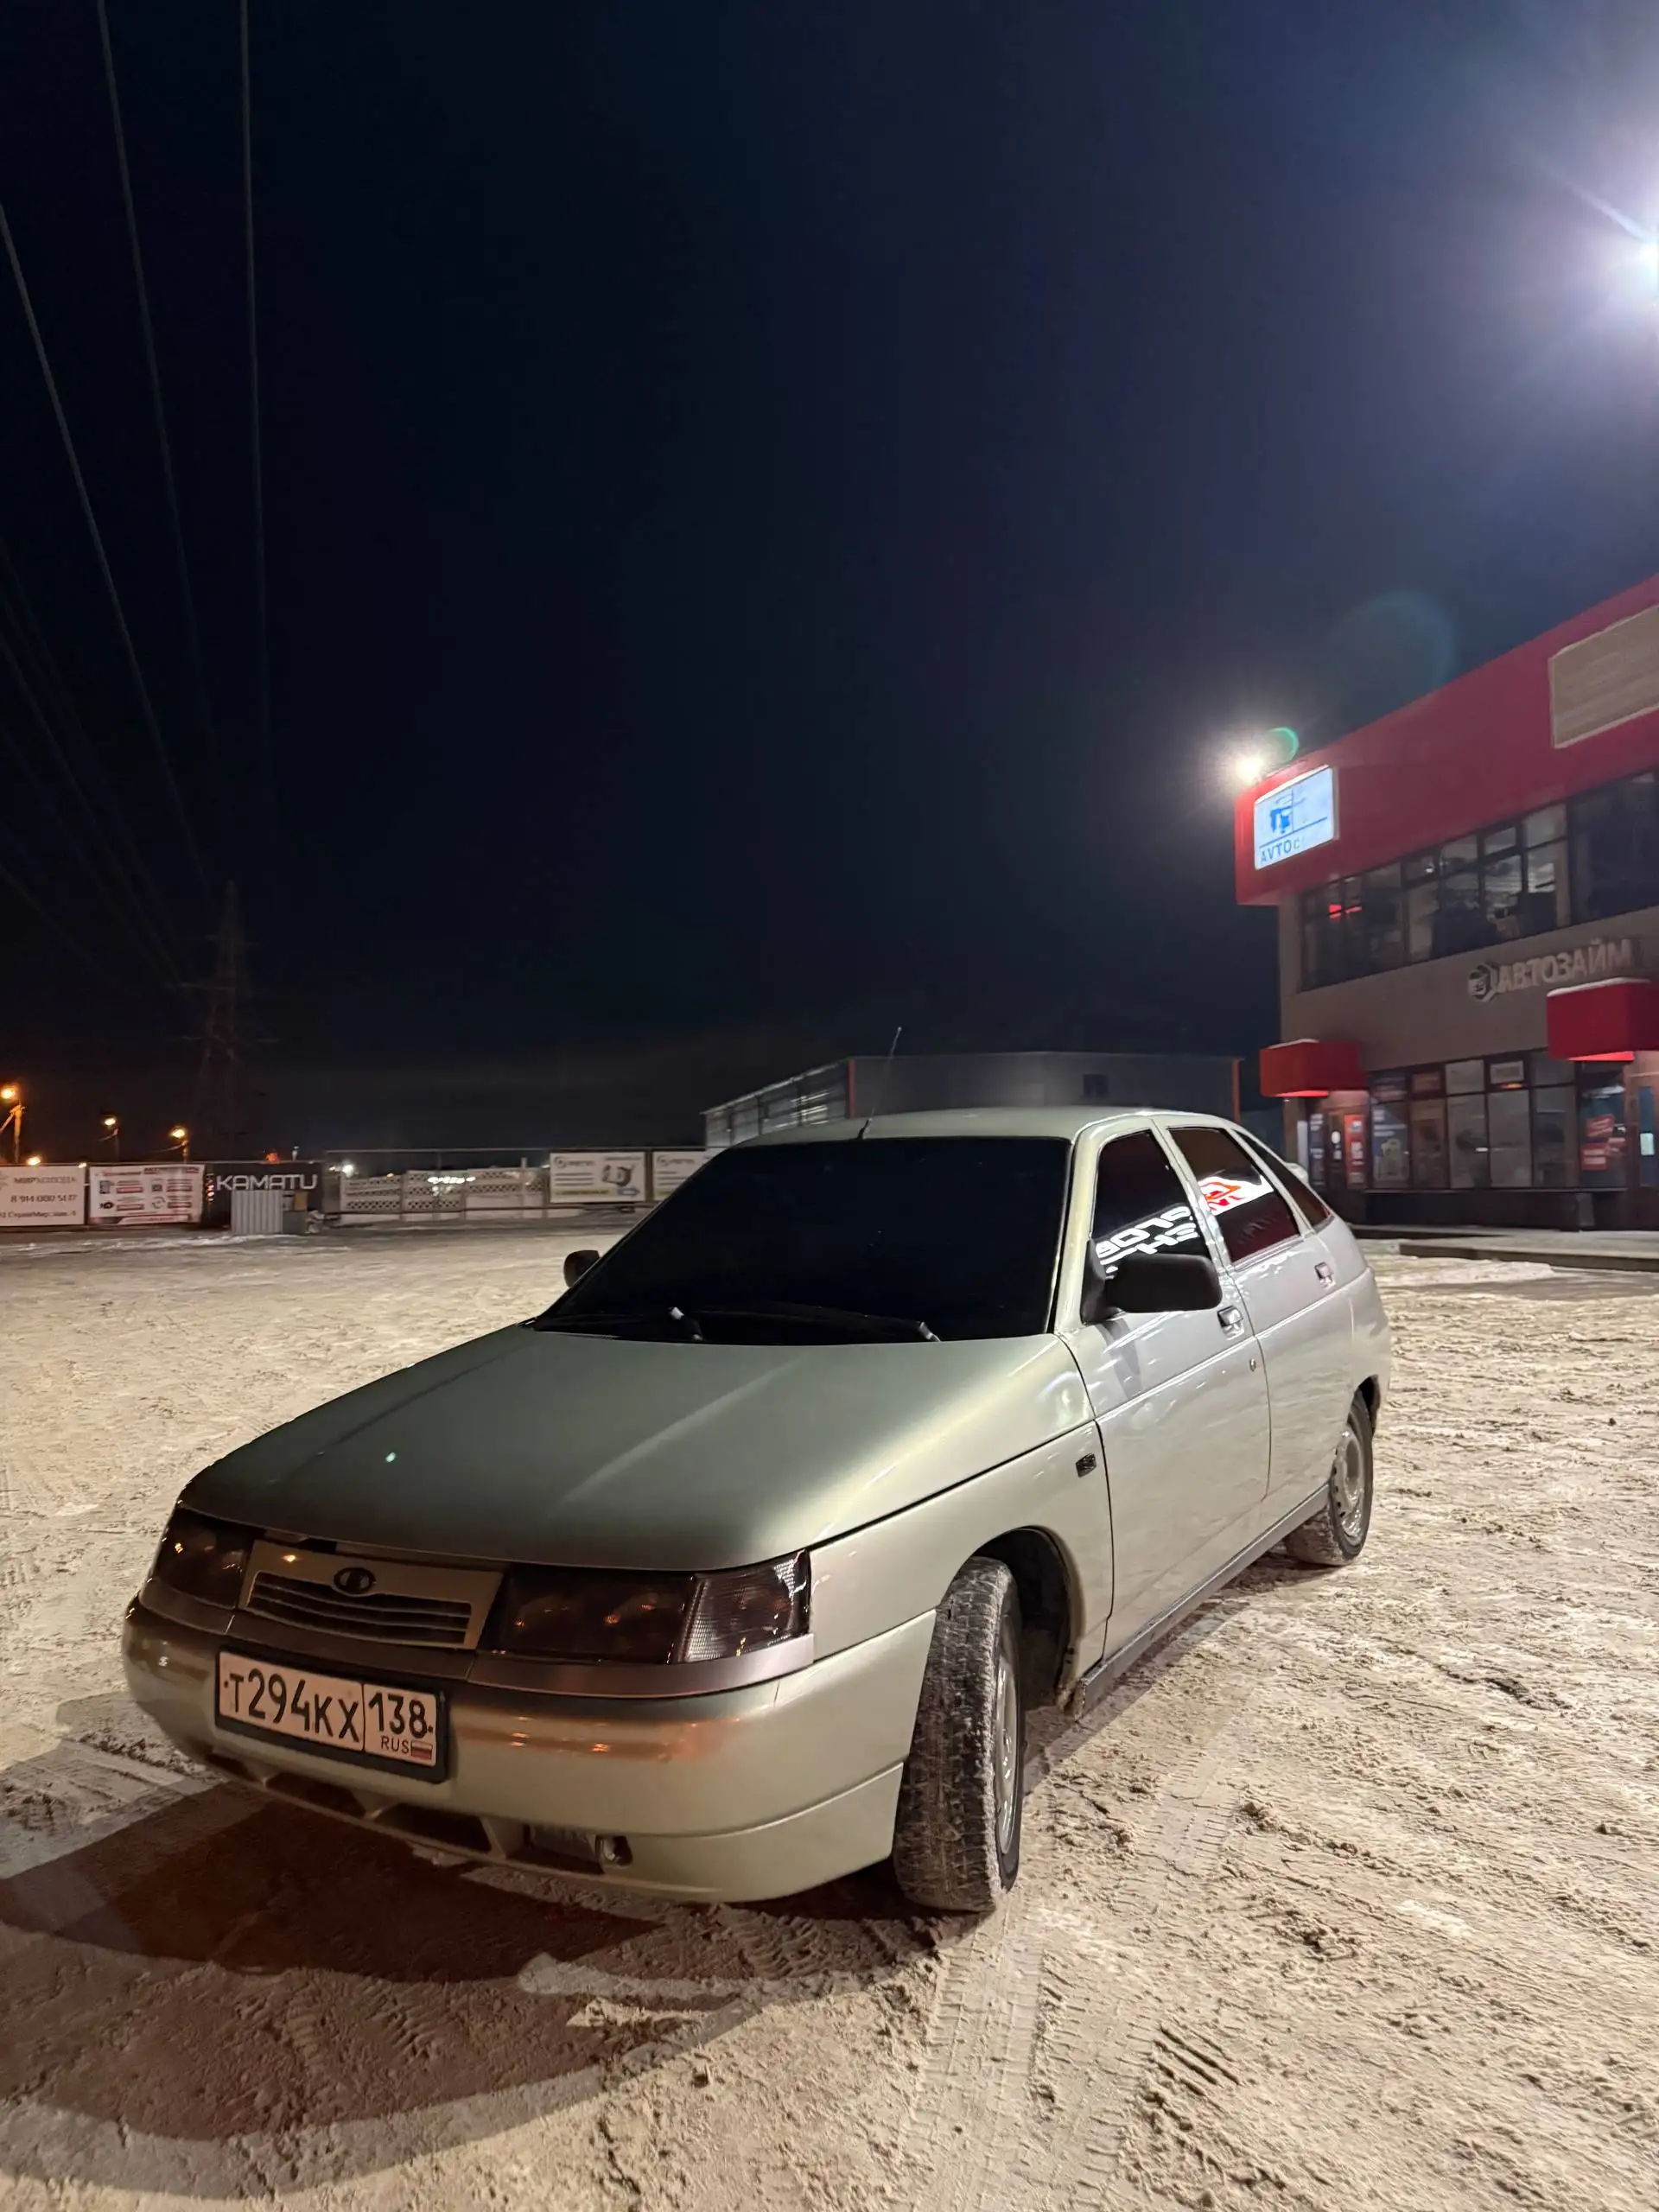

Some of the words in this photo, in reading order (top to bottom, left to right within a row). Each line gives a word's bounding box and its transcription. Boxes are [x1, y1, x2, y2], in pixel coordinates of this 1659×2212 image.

[1497, 938, 1632, 994] АВТОЗАЙМ
[216, 1173, 318, 1191] KAMATU
[368, 1692, 428, 1738] 138
[380, 1735, 410, 1754] RUS
